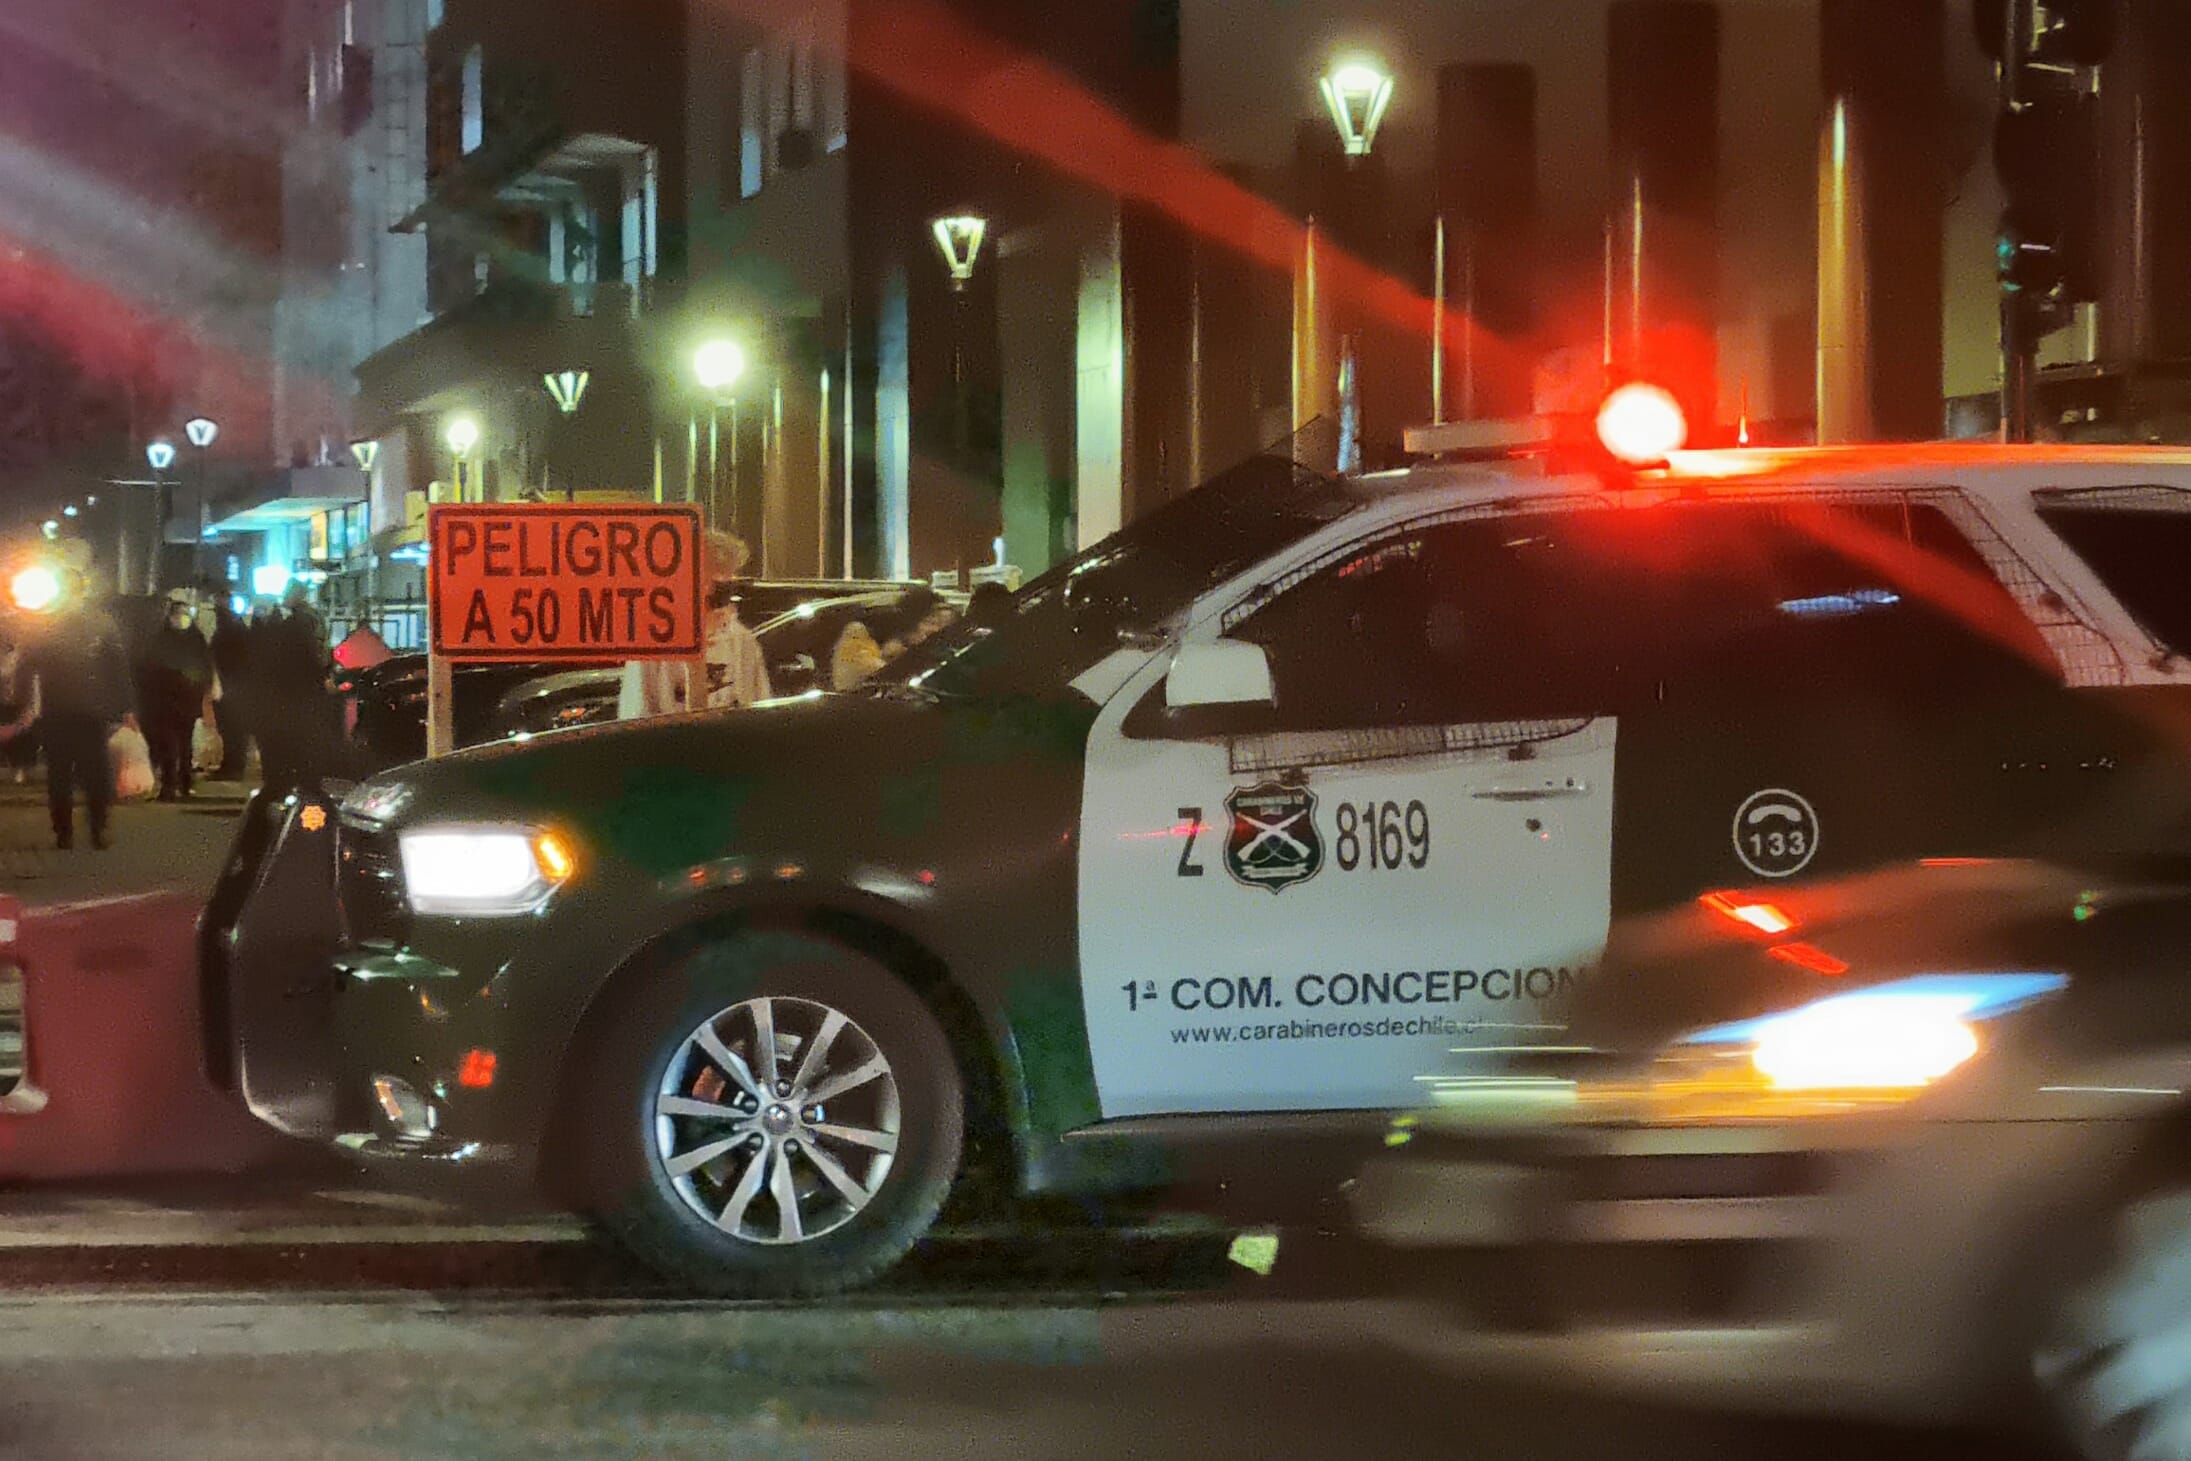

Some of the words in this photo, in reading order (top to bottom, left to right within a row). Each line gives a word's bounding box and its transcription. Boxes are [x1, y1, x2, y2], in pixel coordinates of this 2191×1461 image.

[447, 521, 682, 577] PELIGRO
[461, 588, 496, 643] A
[510, 587, 560, 643] 50
[578, 587, 675, 643] MTS
[1177, 807, 1204, 877] Z
[1336, 799, 1430, 871] 8169
[1749, 831, 1805, 856] 133
[1171, 976, 1282, 1010] COM.
